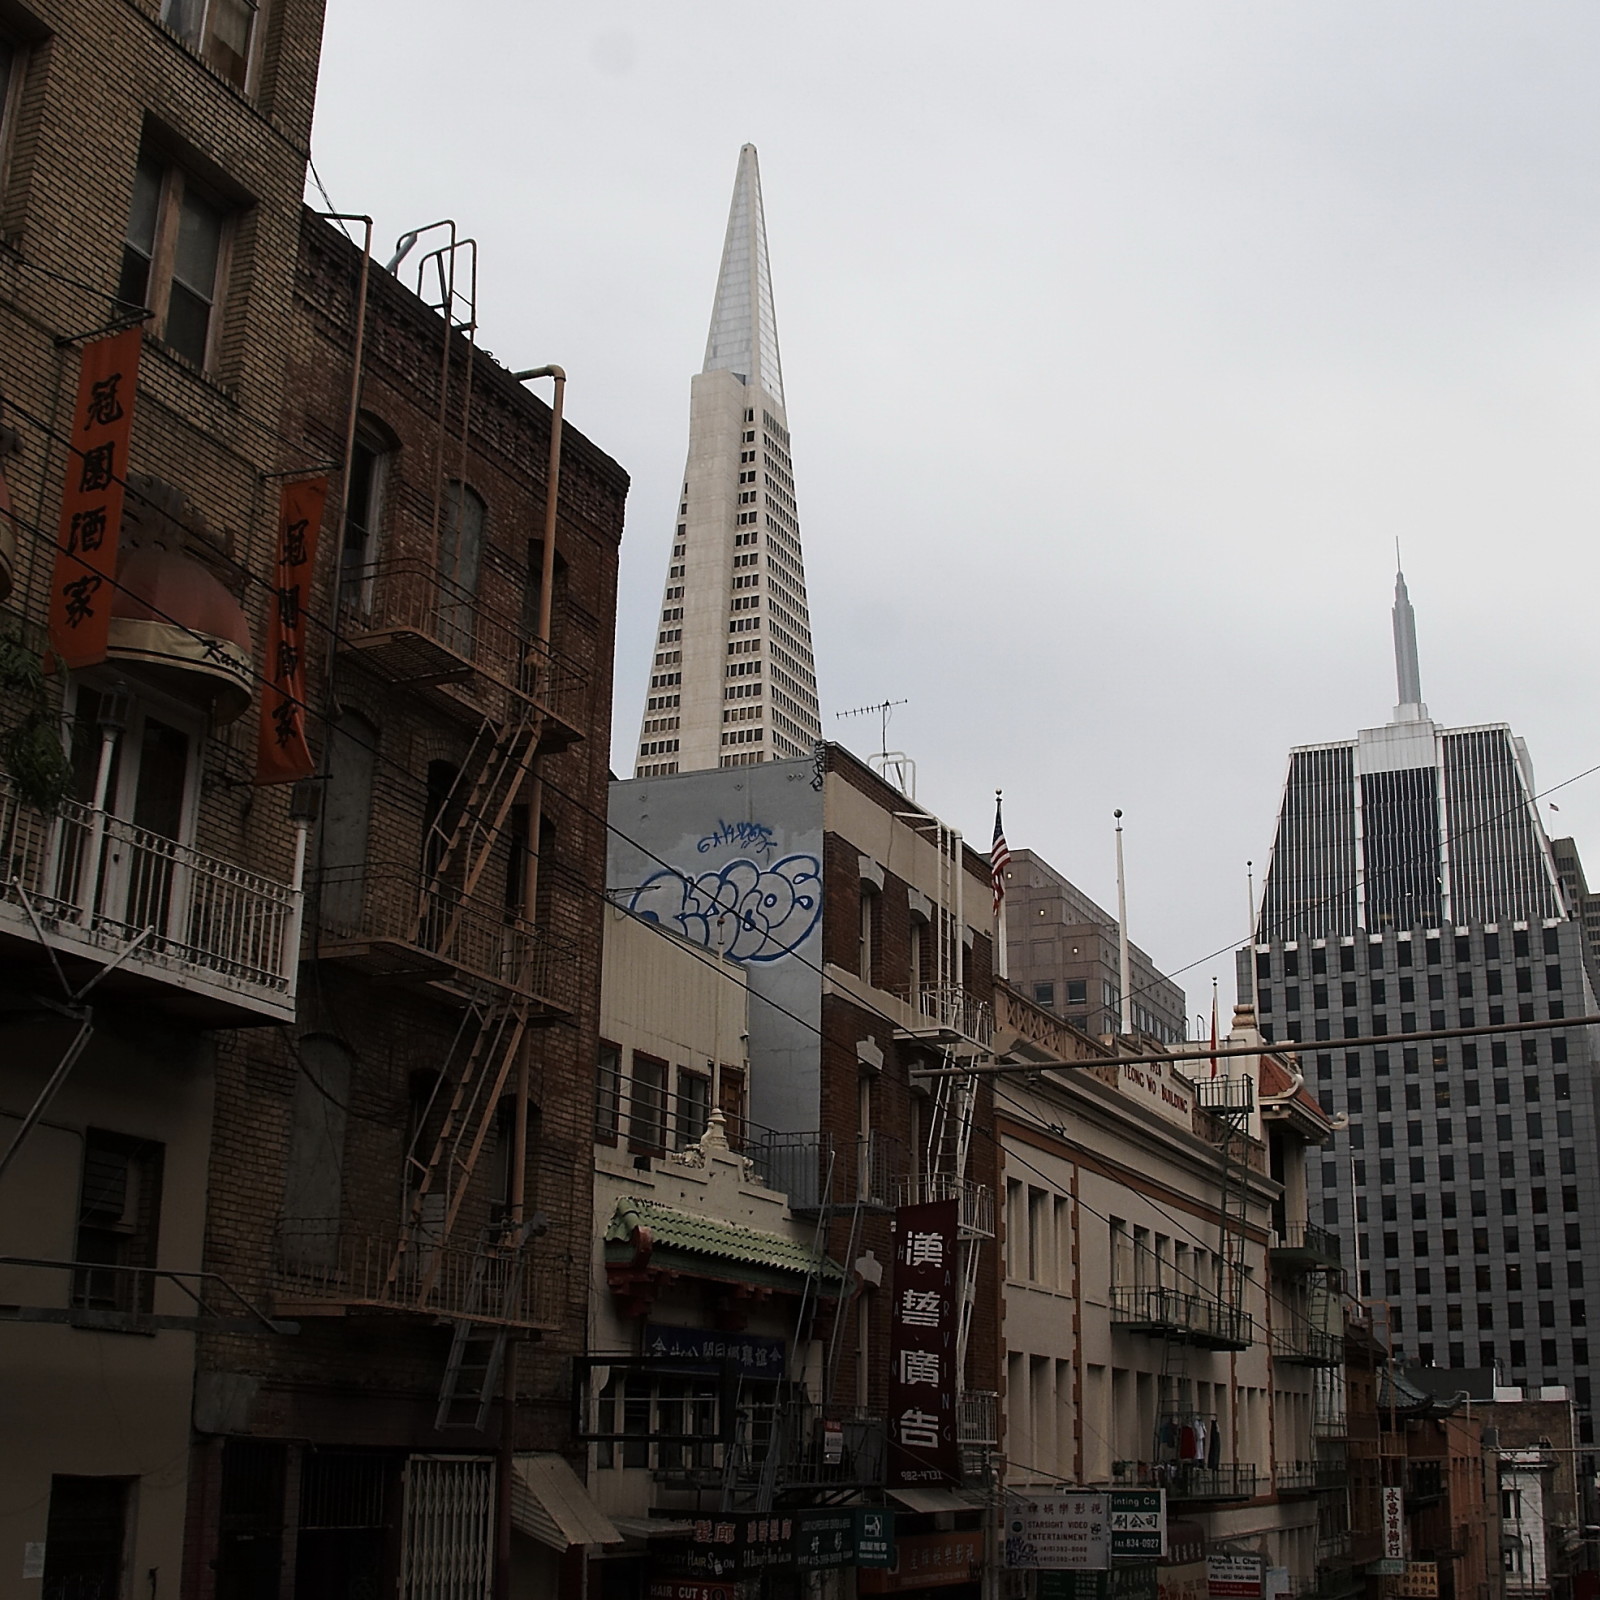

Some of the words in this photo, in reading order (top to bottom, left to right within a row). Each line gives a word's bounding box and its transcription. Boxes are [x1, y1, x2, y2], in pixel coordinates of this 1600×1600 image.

[61, 372, 124, 629] 冠園酒家
[1146, 1074, 1157, 1095] WO
[1161, 1084, 1188, 1114] BUILDING
[900, 1231, 944, 1448] 漢藝廣告
[1113, 1497, 1140, 1508] inting
[1027, 1521, 1063, 1530] STARSIGHT
[1068, 1521, 1088, 1530] VIDEO
[1385, 1488, 1401, 1557] 永昌首飾行
[1027, 1533, 1088, 1541] ENTERTAINMENT
[687, 1549, 707, 1567] HAIR
[650, 1584, 673, 1598] HAIR
[678, 1586, 699, 1600] CUT
